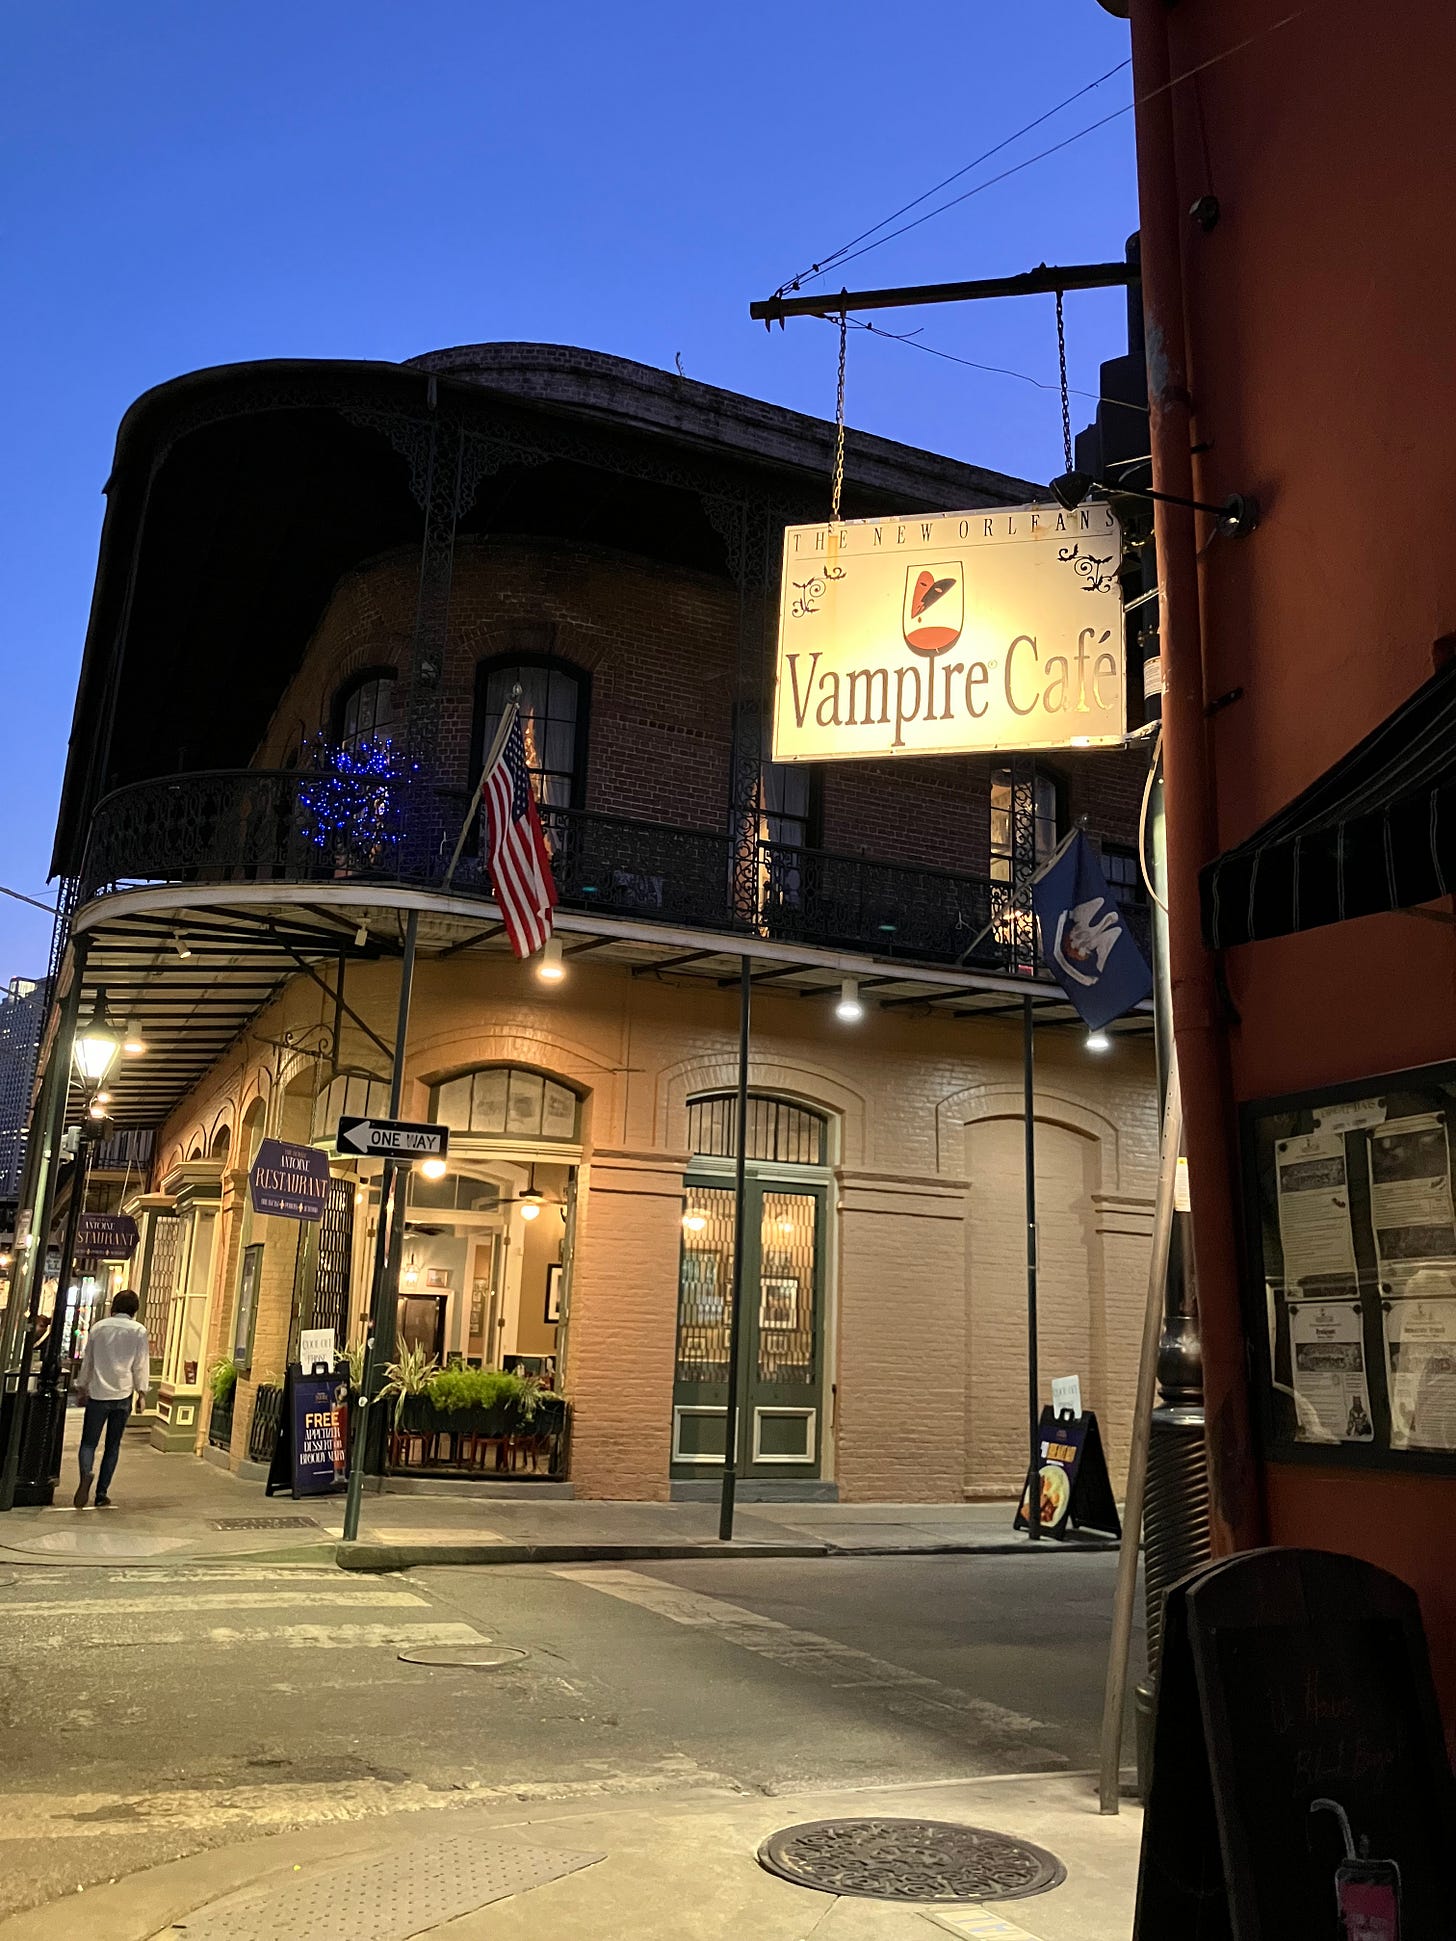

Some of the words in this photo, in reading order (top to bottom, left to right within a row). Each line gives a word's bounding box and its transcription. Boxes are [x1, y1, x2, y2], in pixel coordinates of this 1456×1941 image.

[793, 529, 848, 552] THE
[873, 522, 933, 546] NEW
[958, 508, 1114, 539] ORLEANS
[1004, 627, 1117, 716] Café
[371, 1130, 401, 1147] ONE
[406, 1133, 437, 1150] WAY
[255, 1167, 328, 1198] RESTAURANT
[305, 1411, 340, 1429] FREE
[304, 1426, 341, 1440] APPETIZER
[303, 1439, 332, 1452] DESSERT
